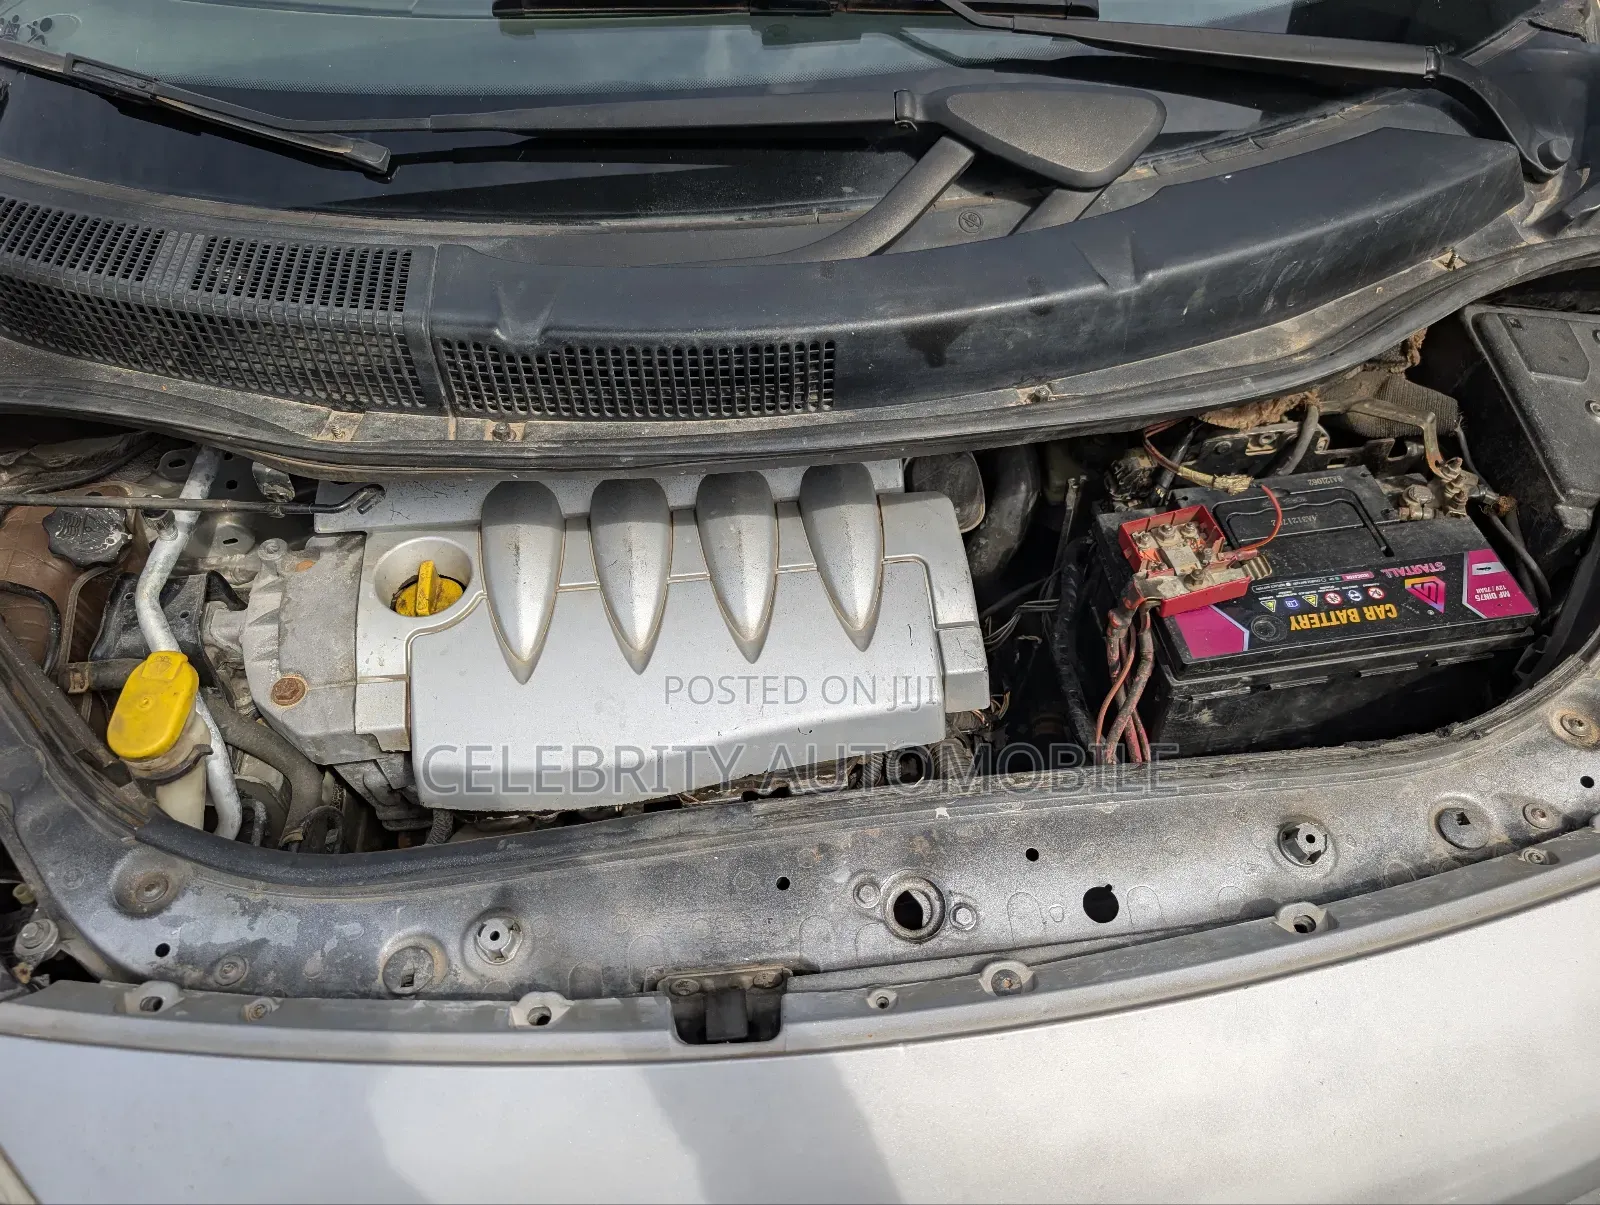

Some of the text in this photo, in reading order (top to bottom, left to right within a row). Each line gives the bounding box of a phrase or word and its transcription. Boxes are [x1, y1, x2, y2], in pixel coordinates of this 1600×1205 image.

[1380, 561, 1446, 579] STARTALL
[1290, 608, 1360, 630] BATTERY
[1362, 603, 1398, 621] CAR
